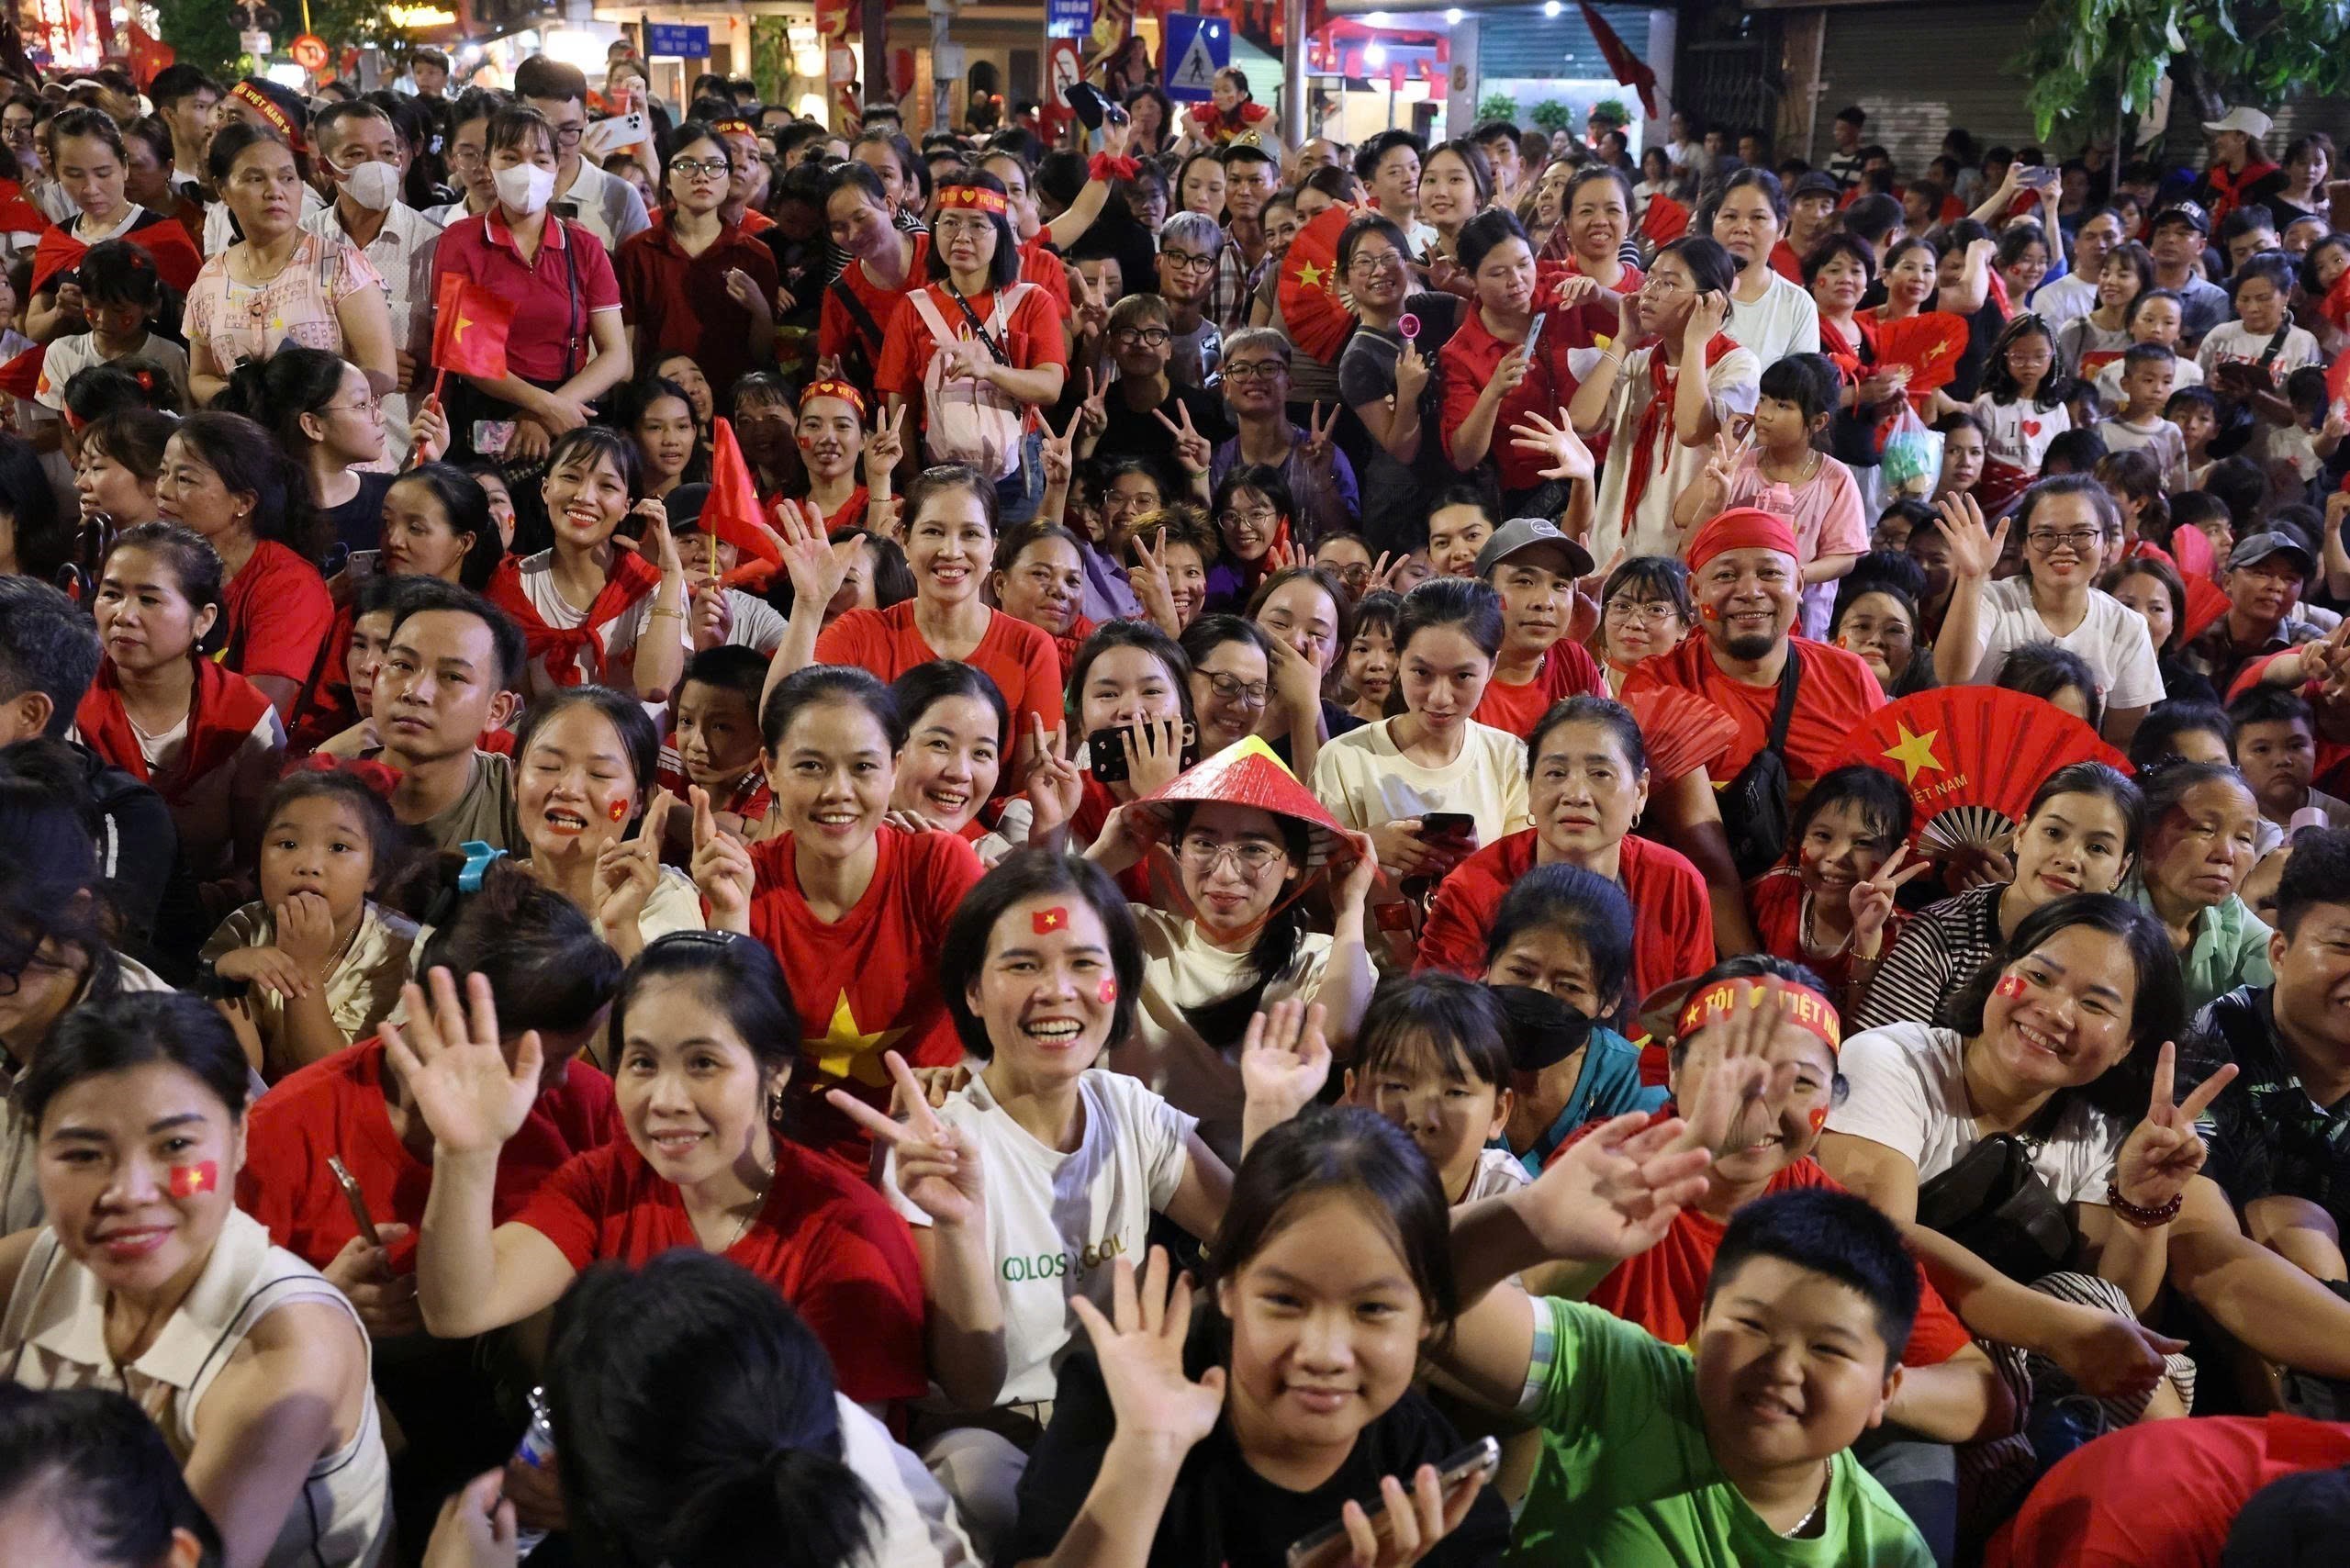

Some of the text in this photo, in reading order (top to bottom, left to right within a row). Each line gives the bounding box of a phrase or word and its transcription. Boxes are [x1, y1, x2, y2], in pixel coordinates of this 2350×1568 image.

[245, 89, 267, 108] VIỆT
[263, 104, 285, 128] NAM
[837, 386, 854, 399] VIỆT
[1913, 773, 1968, 808] ỆT NAM
